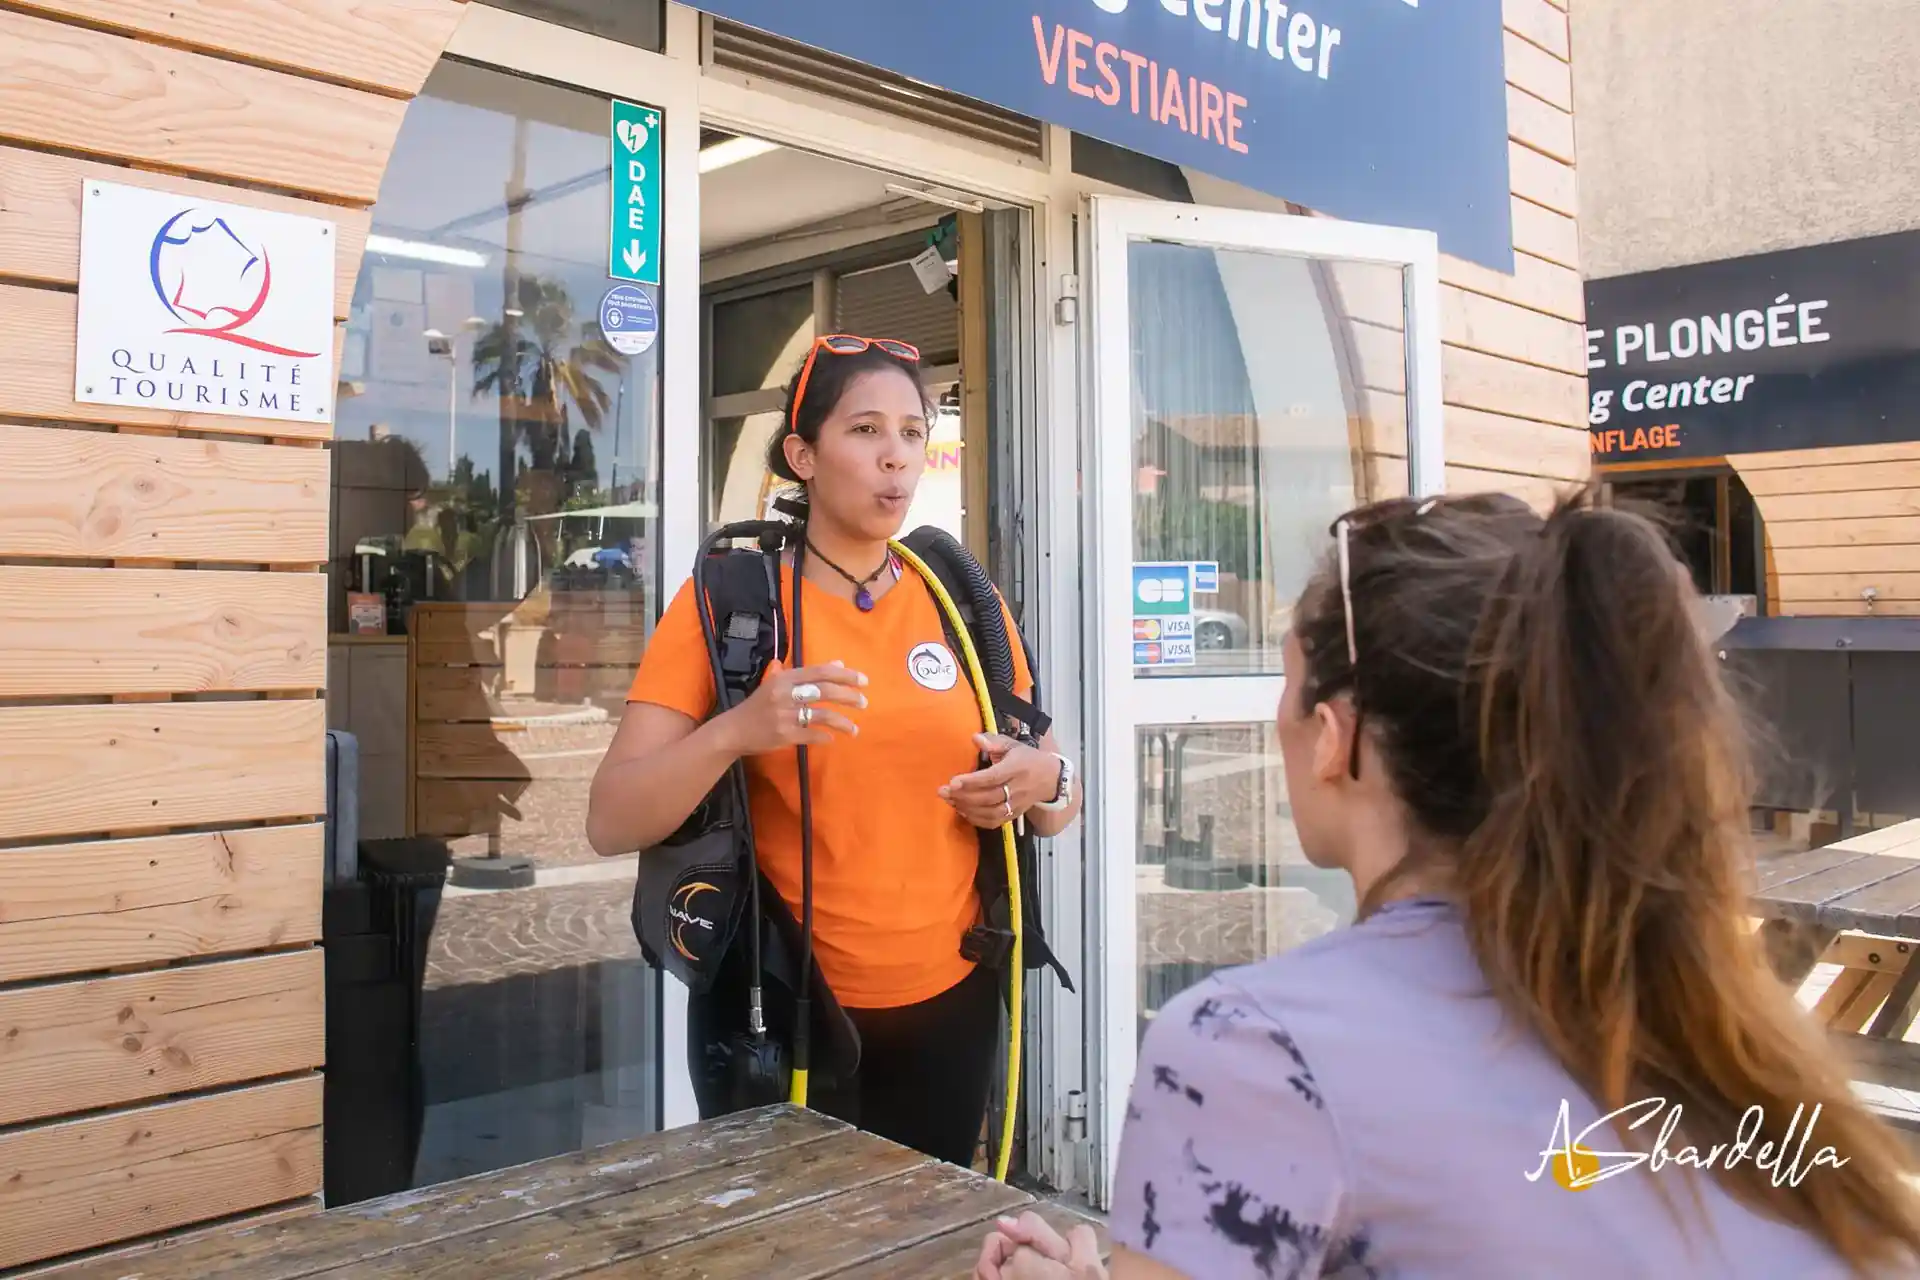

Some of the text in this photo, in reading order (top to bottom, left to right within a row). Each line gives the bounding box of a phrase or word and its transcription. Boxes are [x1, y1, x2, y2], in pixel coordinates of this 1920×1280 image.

[1032, 15, 1249, 155] VESTIAIRE
[627, 159, 647, 231] DAE
[1616, 292, 1831, 366] PLONGÉE
[111, 348, 302, 387] QUALITÉ
[110, 376, 302, 413] TOURISME
[1621, 374, 1755, 413] Center
[1167, 620, 1191, 633] VISA
[1167, 643, 1192, 656] VISA
